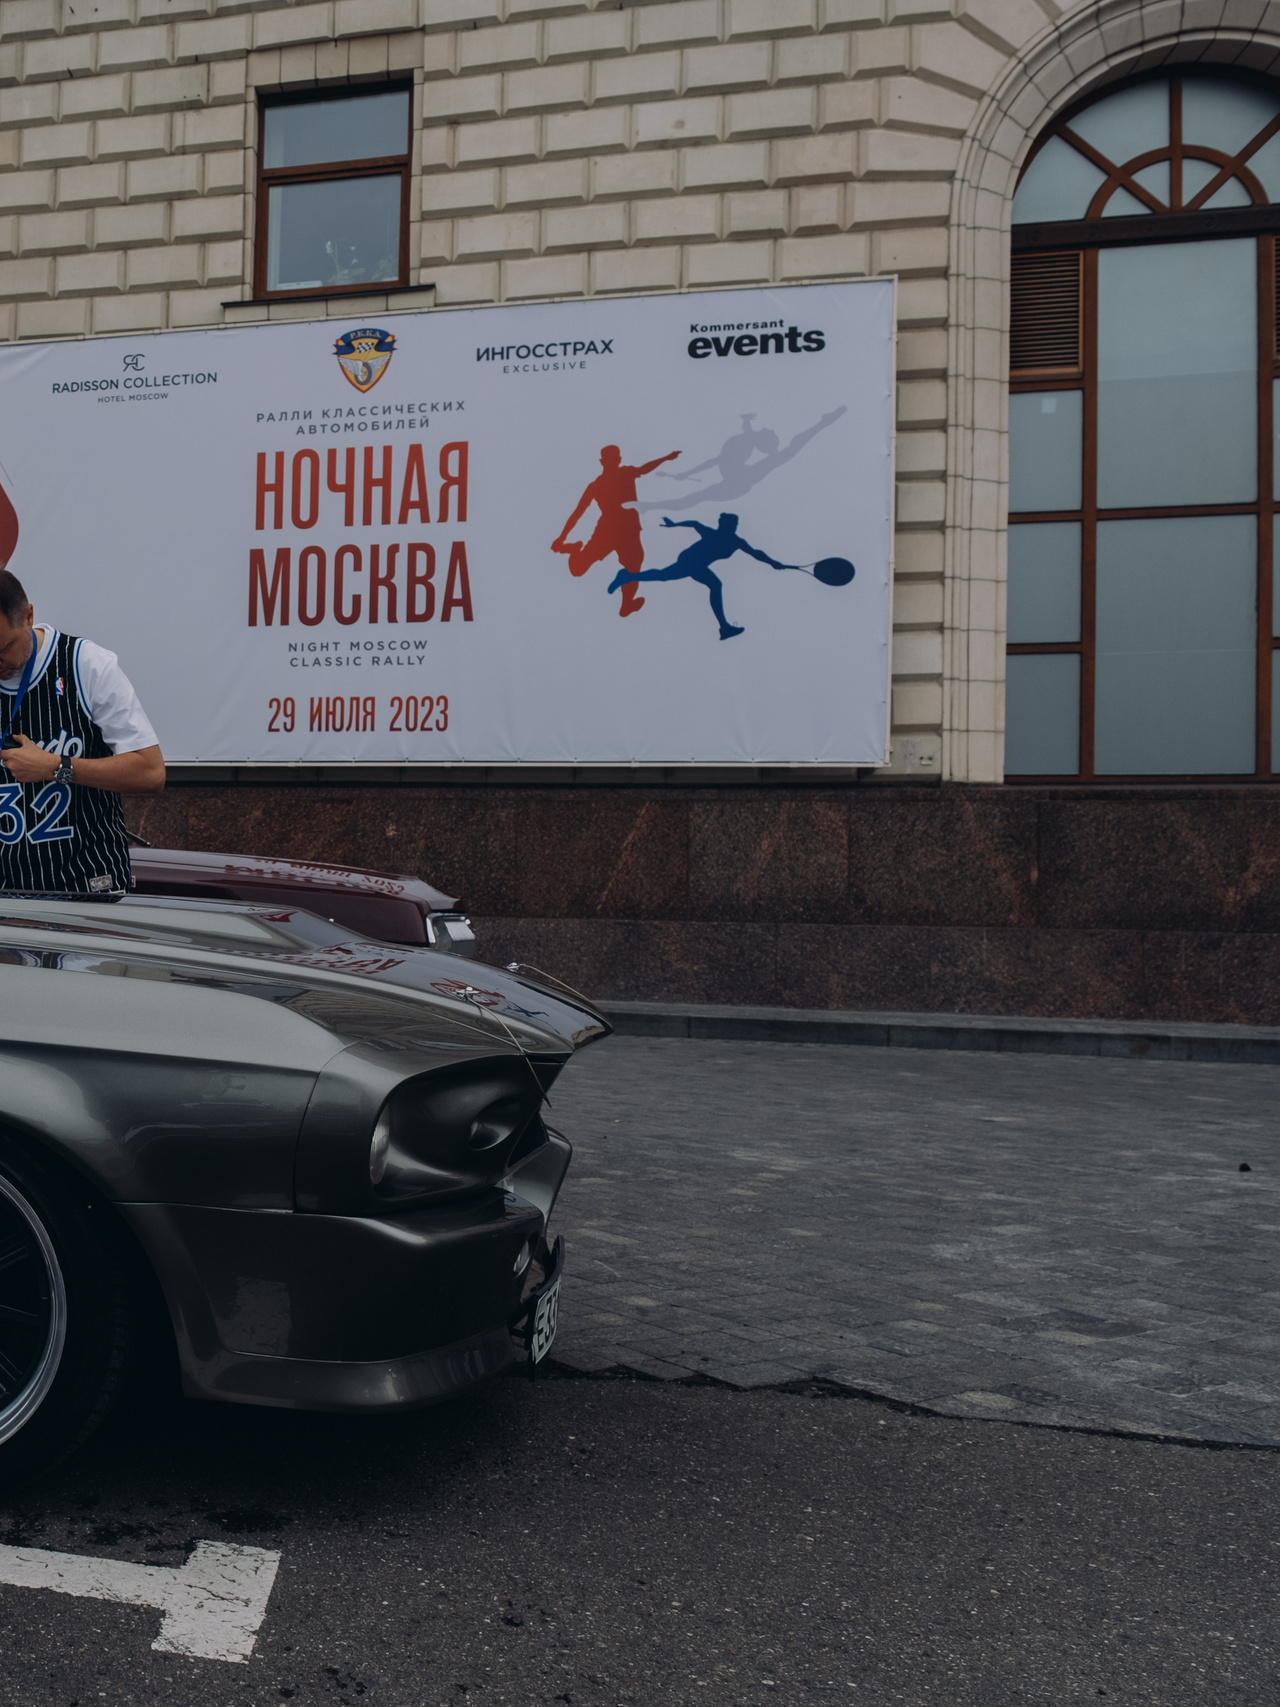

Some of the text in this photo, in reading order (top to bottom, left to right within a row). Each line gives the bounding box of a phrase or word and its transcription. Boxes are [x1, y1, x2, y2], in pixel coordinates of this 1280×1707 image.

[690, 319, 784, 333] Kommersant
[476, 339, 614, 361] ИНГОССТРАХ
[688, 326, 826, 359] events
[503, 361, 586, 373] EXCLUSIVE
[52, 372, 218, 393] RADISSON COLLECTION
[97, 393, 169, 403] HOTEL MOSCOW
[256, 401, 465, 423] РАЛЛИ КЛАССИЧЕСКИХ
[296, 415, 430, 435] АВТОМОБИЛЕЙ
[255, 441, 469, 530] НОЧНАЯ
[248, 541, 474, 627] МОСКВА
[288, 640, 428, 652] NIGHT MOSCOW
[290, 655, 426, 667] CLASSIC RALLY
[268, 695, 449, 733] 29 ИЮЛЯ 2023
